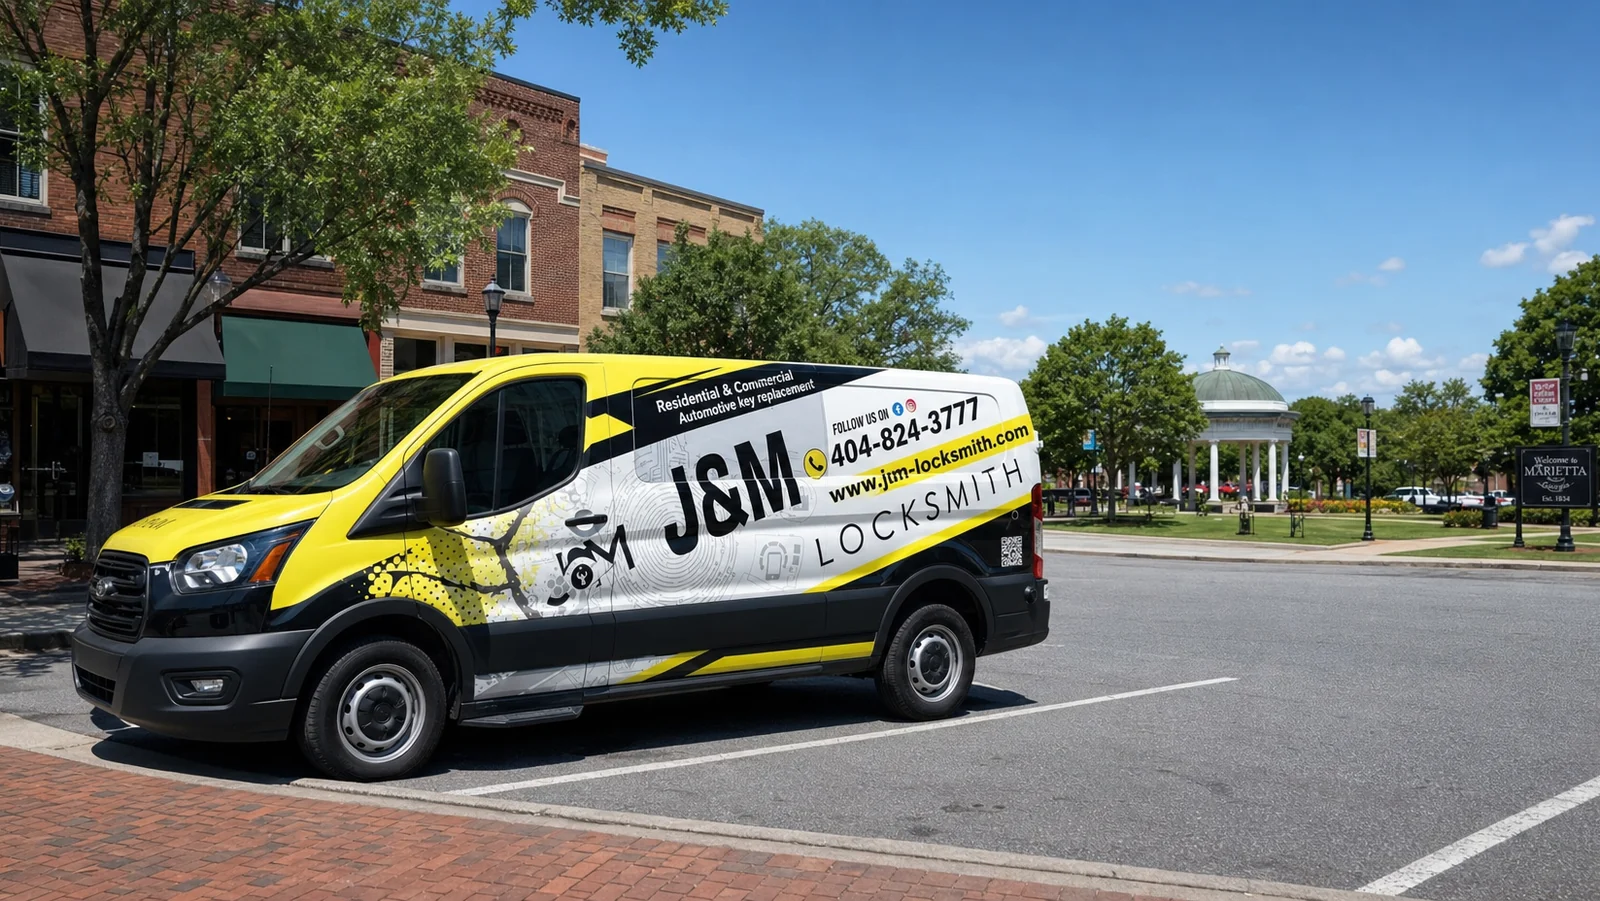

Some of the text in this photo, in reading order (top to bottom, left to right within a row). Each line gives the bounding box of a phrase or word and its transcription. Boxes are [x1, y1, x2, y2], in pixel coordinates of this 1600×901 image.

[656, 369, 795, 413] Residential & Commercial
[678, 378, 815, 425] Automotive key replacement
[831, 396, 978, 468] 404-824-3777
[832, 408, 890, 436] FOLLOW US ON
[1524, 465, 1587, 476] MARIETTA
[1533, 455, 1569, 464] Welcome
[664, 430, 802, 555] J&M
[815, 458, 1023, 567] LOCKSMITH
